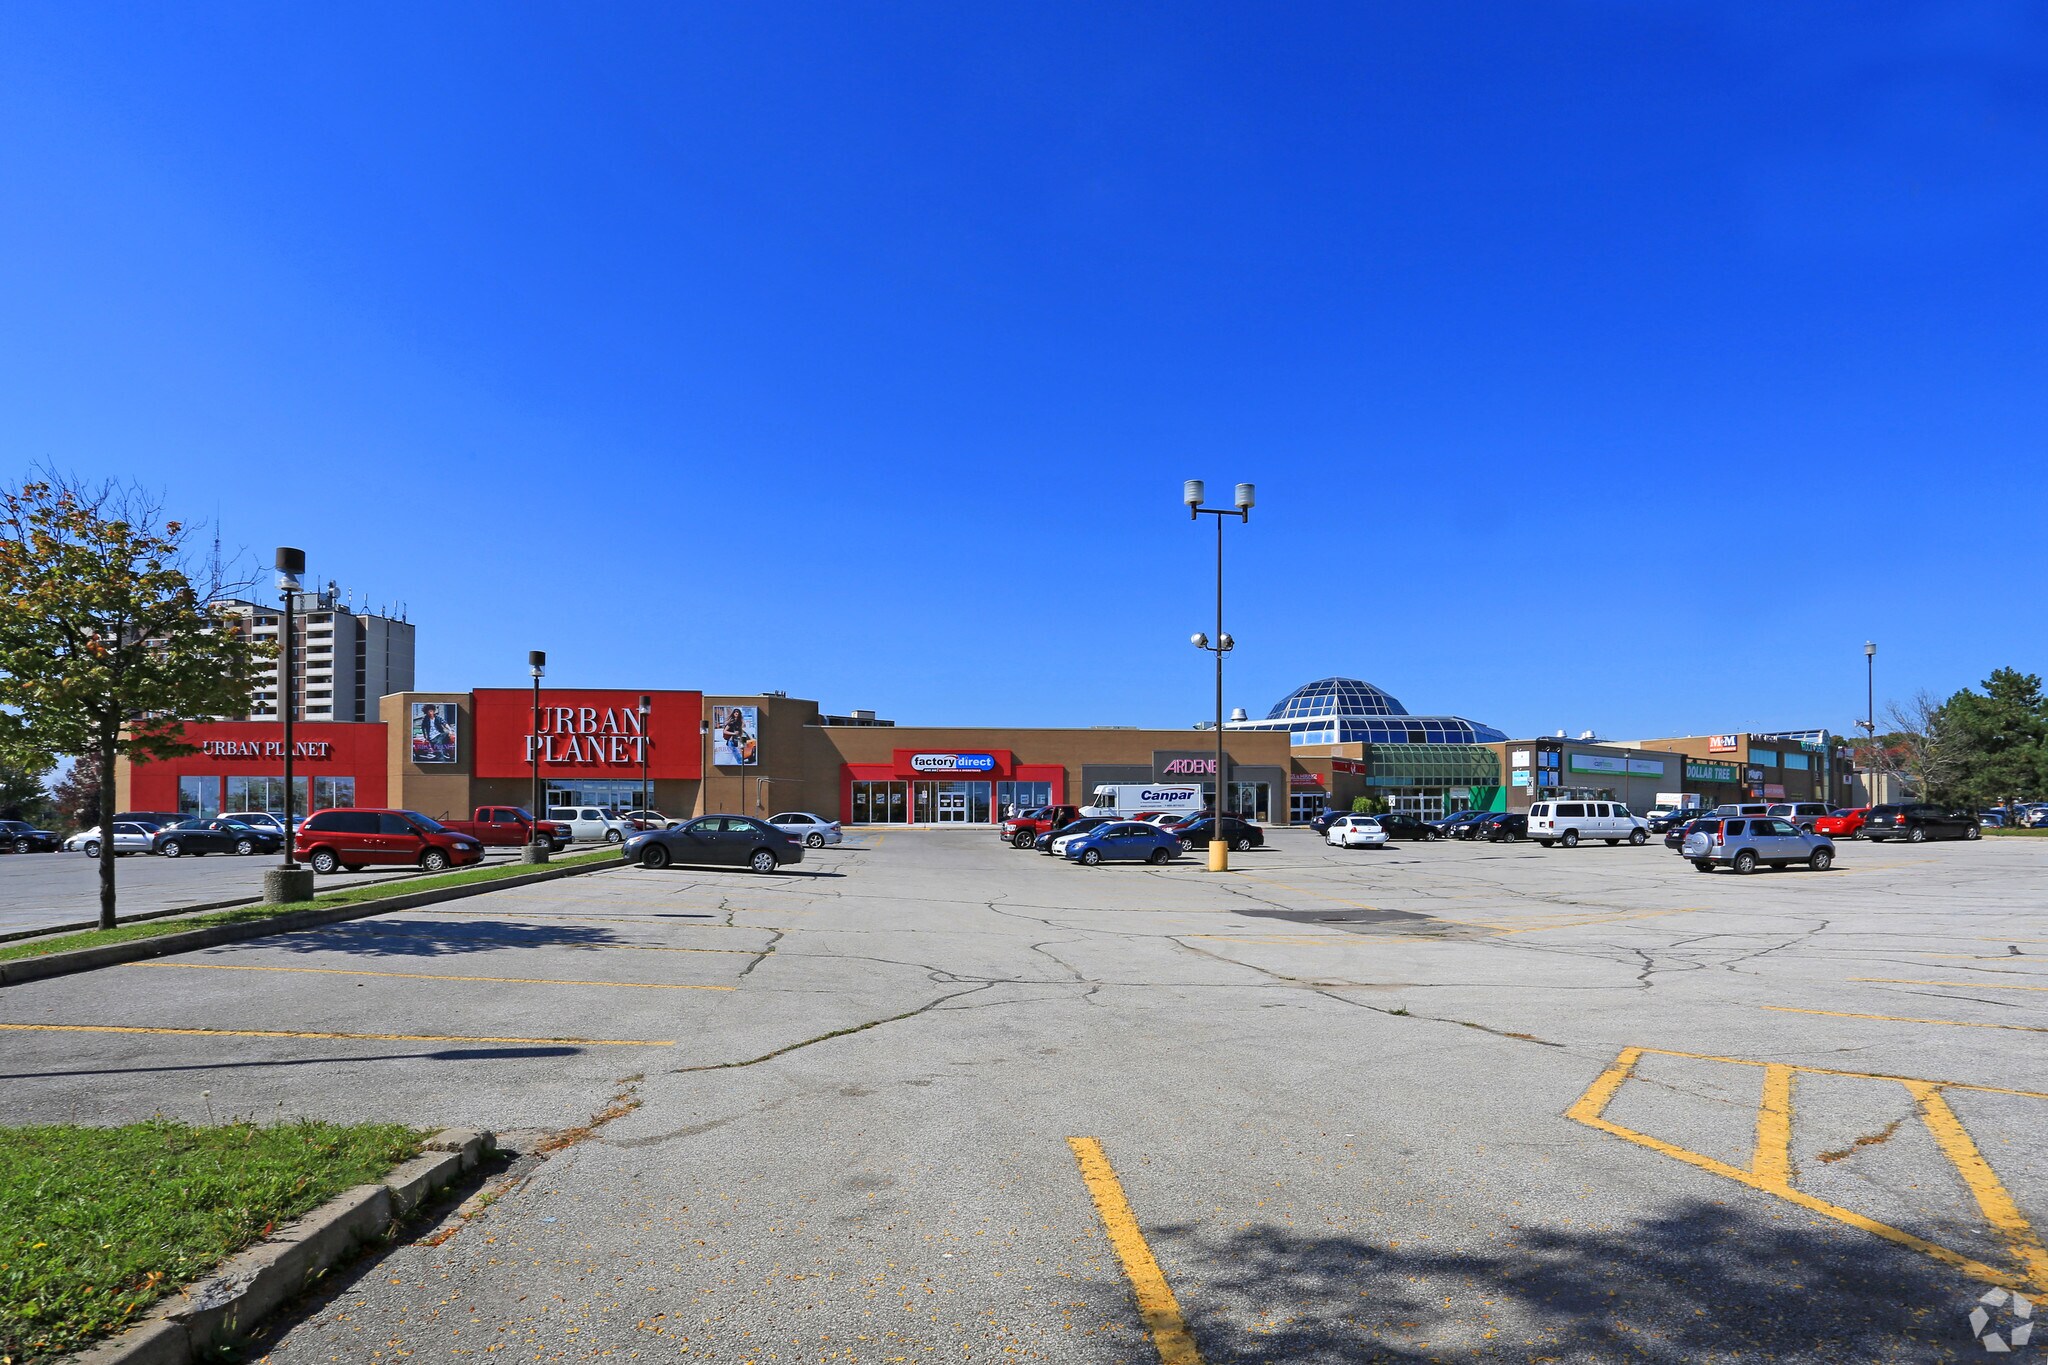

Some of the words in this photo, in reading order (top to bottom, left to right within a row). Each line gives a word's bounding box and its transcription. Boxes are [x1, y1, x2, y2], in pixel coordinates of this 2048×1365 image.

[202, 740, 261, 756] URBAN
[524, 735, 650, 763] PLANET
[914, 757, 955, 767] factory
[958, 757, 992, 766] direct
[1686, 765, 1713, 779] DOLLAR
[1714, 767, 1731, 780] TREE
[1141, 790, 1195, 802] Canpar
